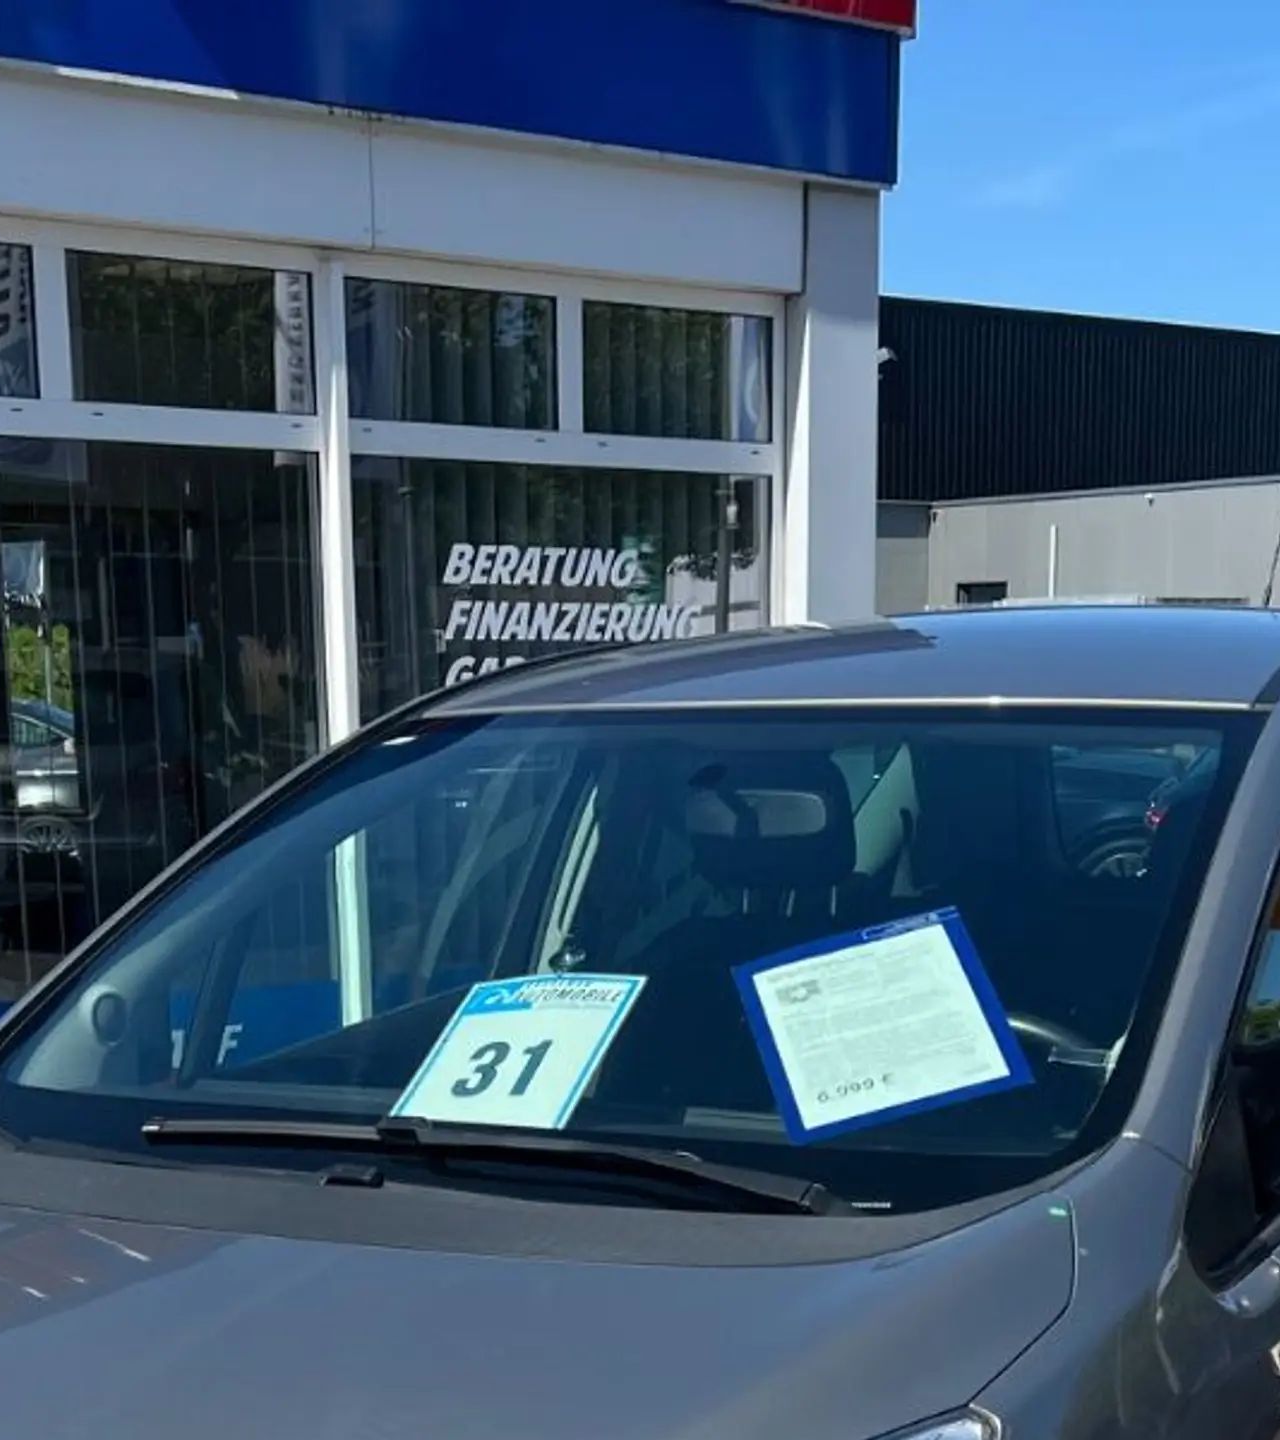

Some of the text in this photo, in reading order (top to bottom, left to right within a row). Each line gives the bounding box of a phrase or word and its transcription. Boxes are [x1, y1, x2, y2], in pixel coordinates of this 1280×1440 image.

[443, 543, 639, 588] BERATUNG
[445, 600, 701, 642] FINANZIERUNG
[451, 1039, 553, 1097] 31
